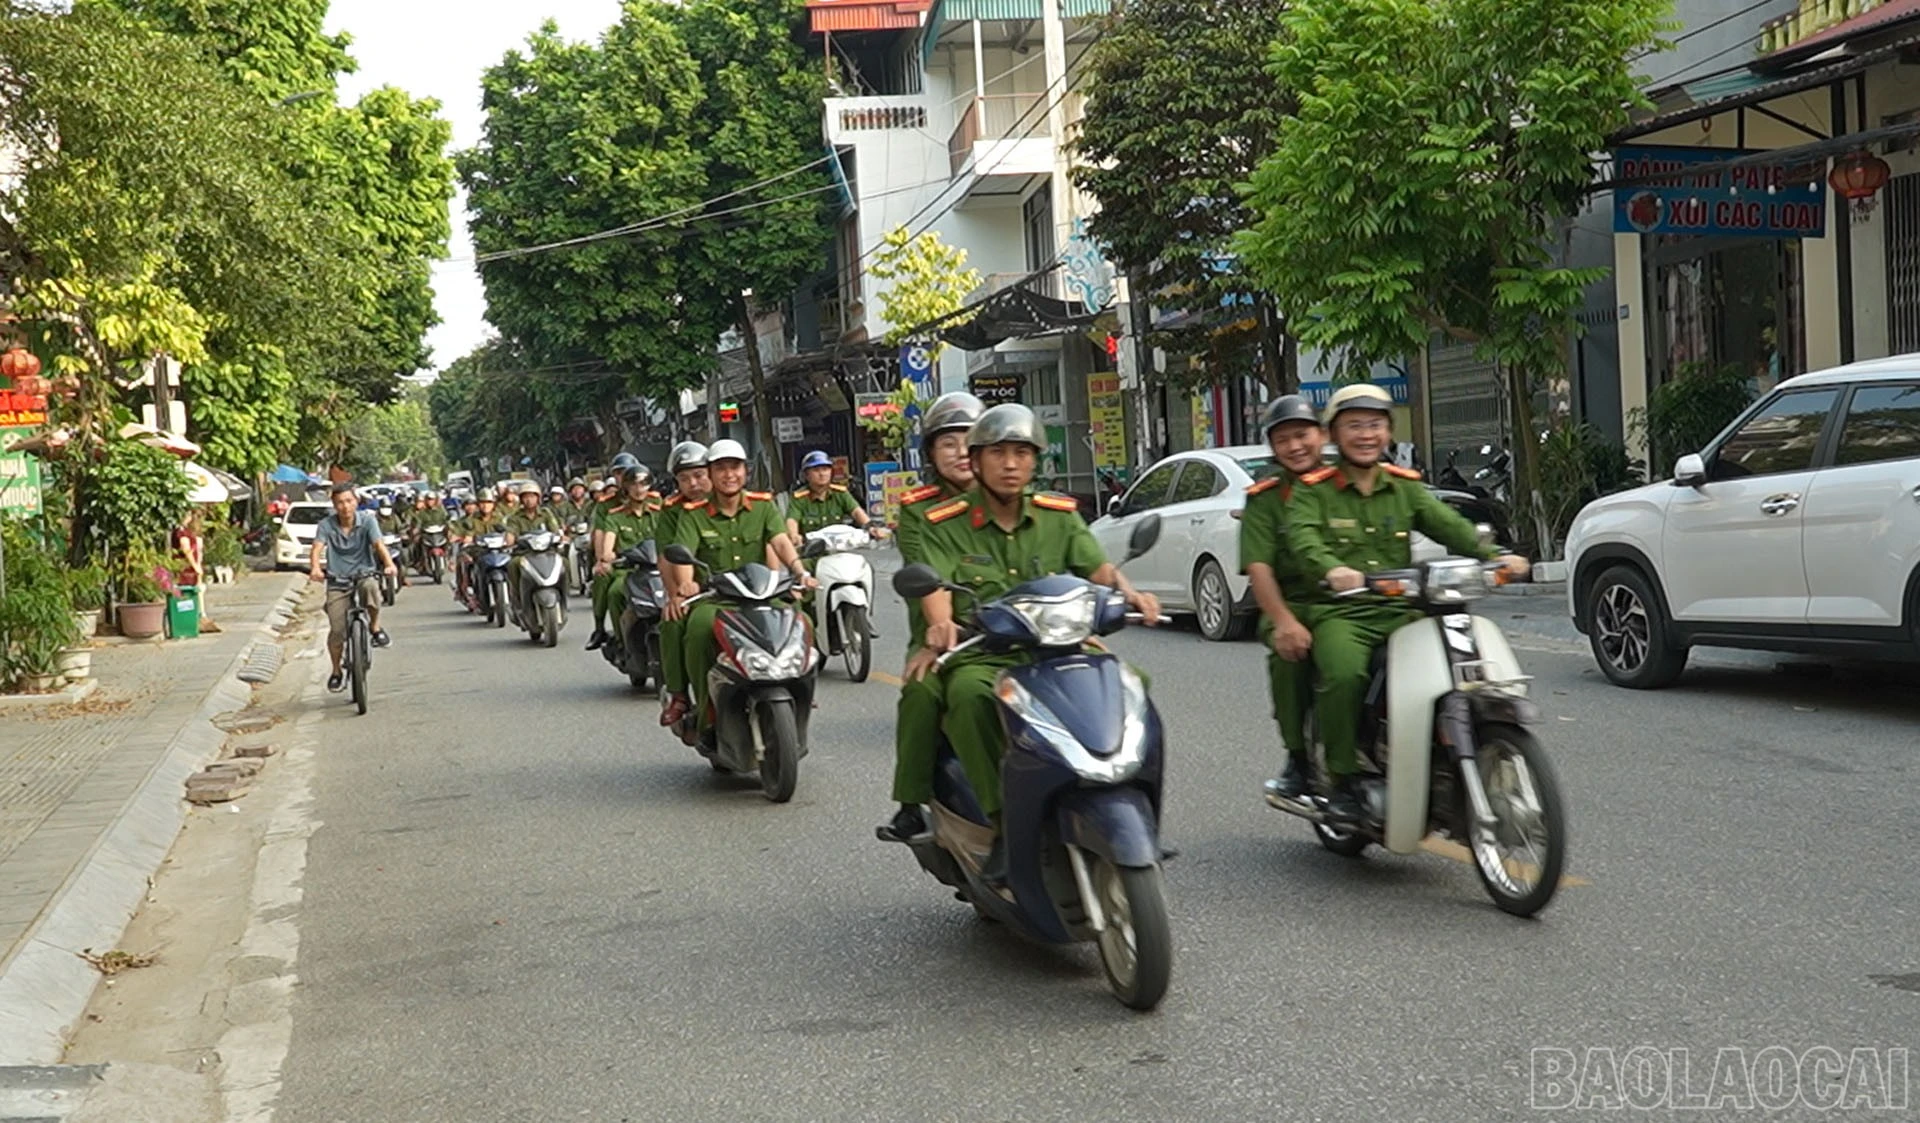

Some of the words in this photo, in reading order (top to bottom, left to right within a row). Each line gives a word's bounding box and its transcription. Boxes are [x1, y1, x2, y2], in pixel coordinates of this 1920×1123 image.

[1715, 198, 1762, 228] CÁC
[1769, 203, 1821, 234] LOẠI
[0, 480, 37, 507] HUỐC
